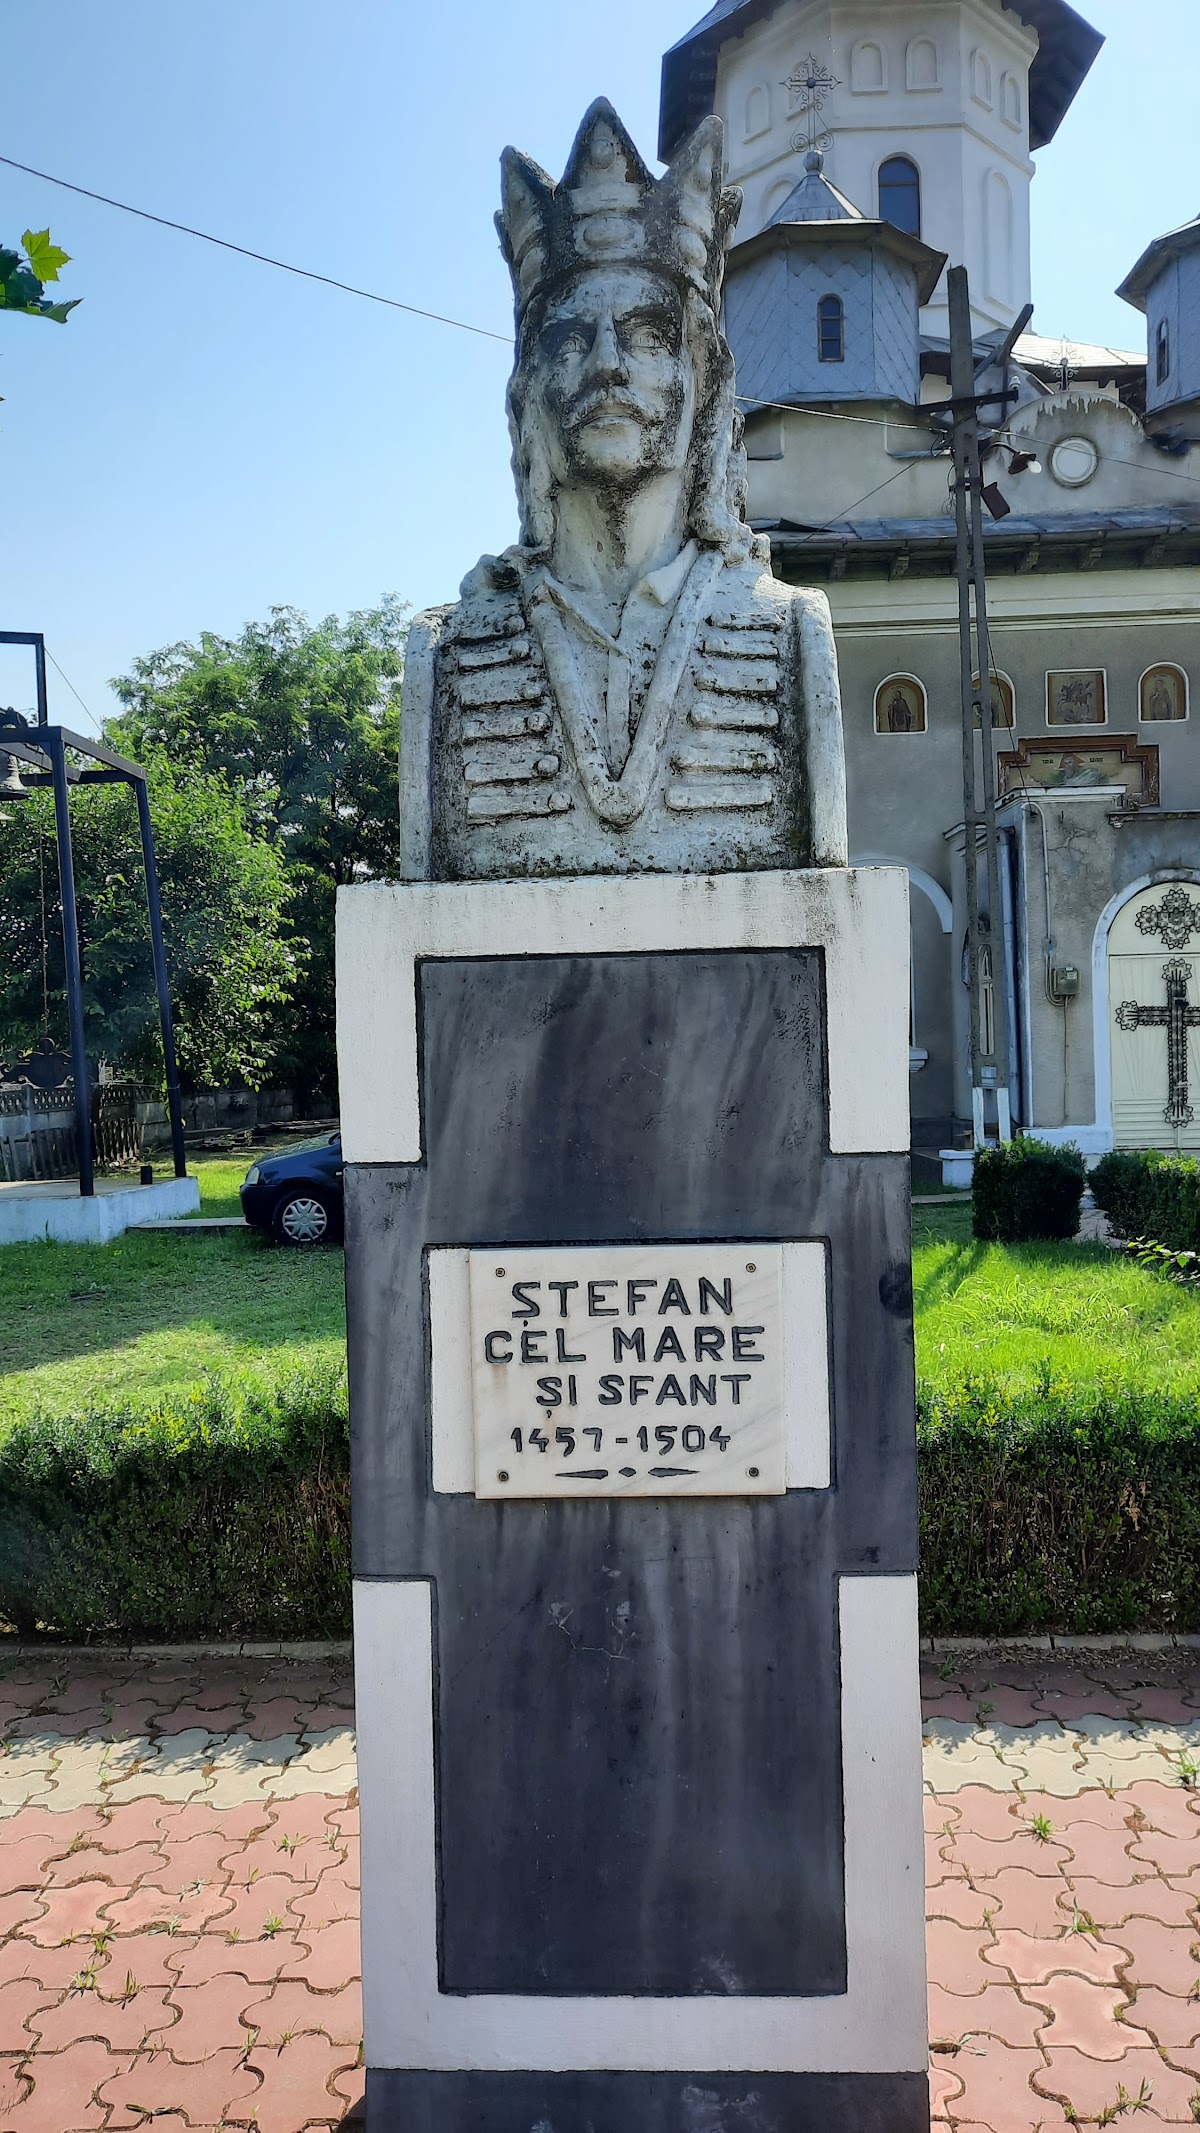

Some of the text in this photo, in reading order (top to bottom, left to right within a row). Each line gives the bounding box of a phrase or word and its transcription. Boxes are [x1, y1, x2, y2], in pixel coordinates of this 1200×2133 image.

[484, 1325, 766, 1365] CEL MARE
[597, 1373, 752, 1407] SFANT
